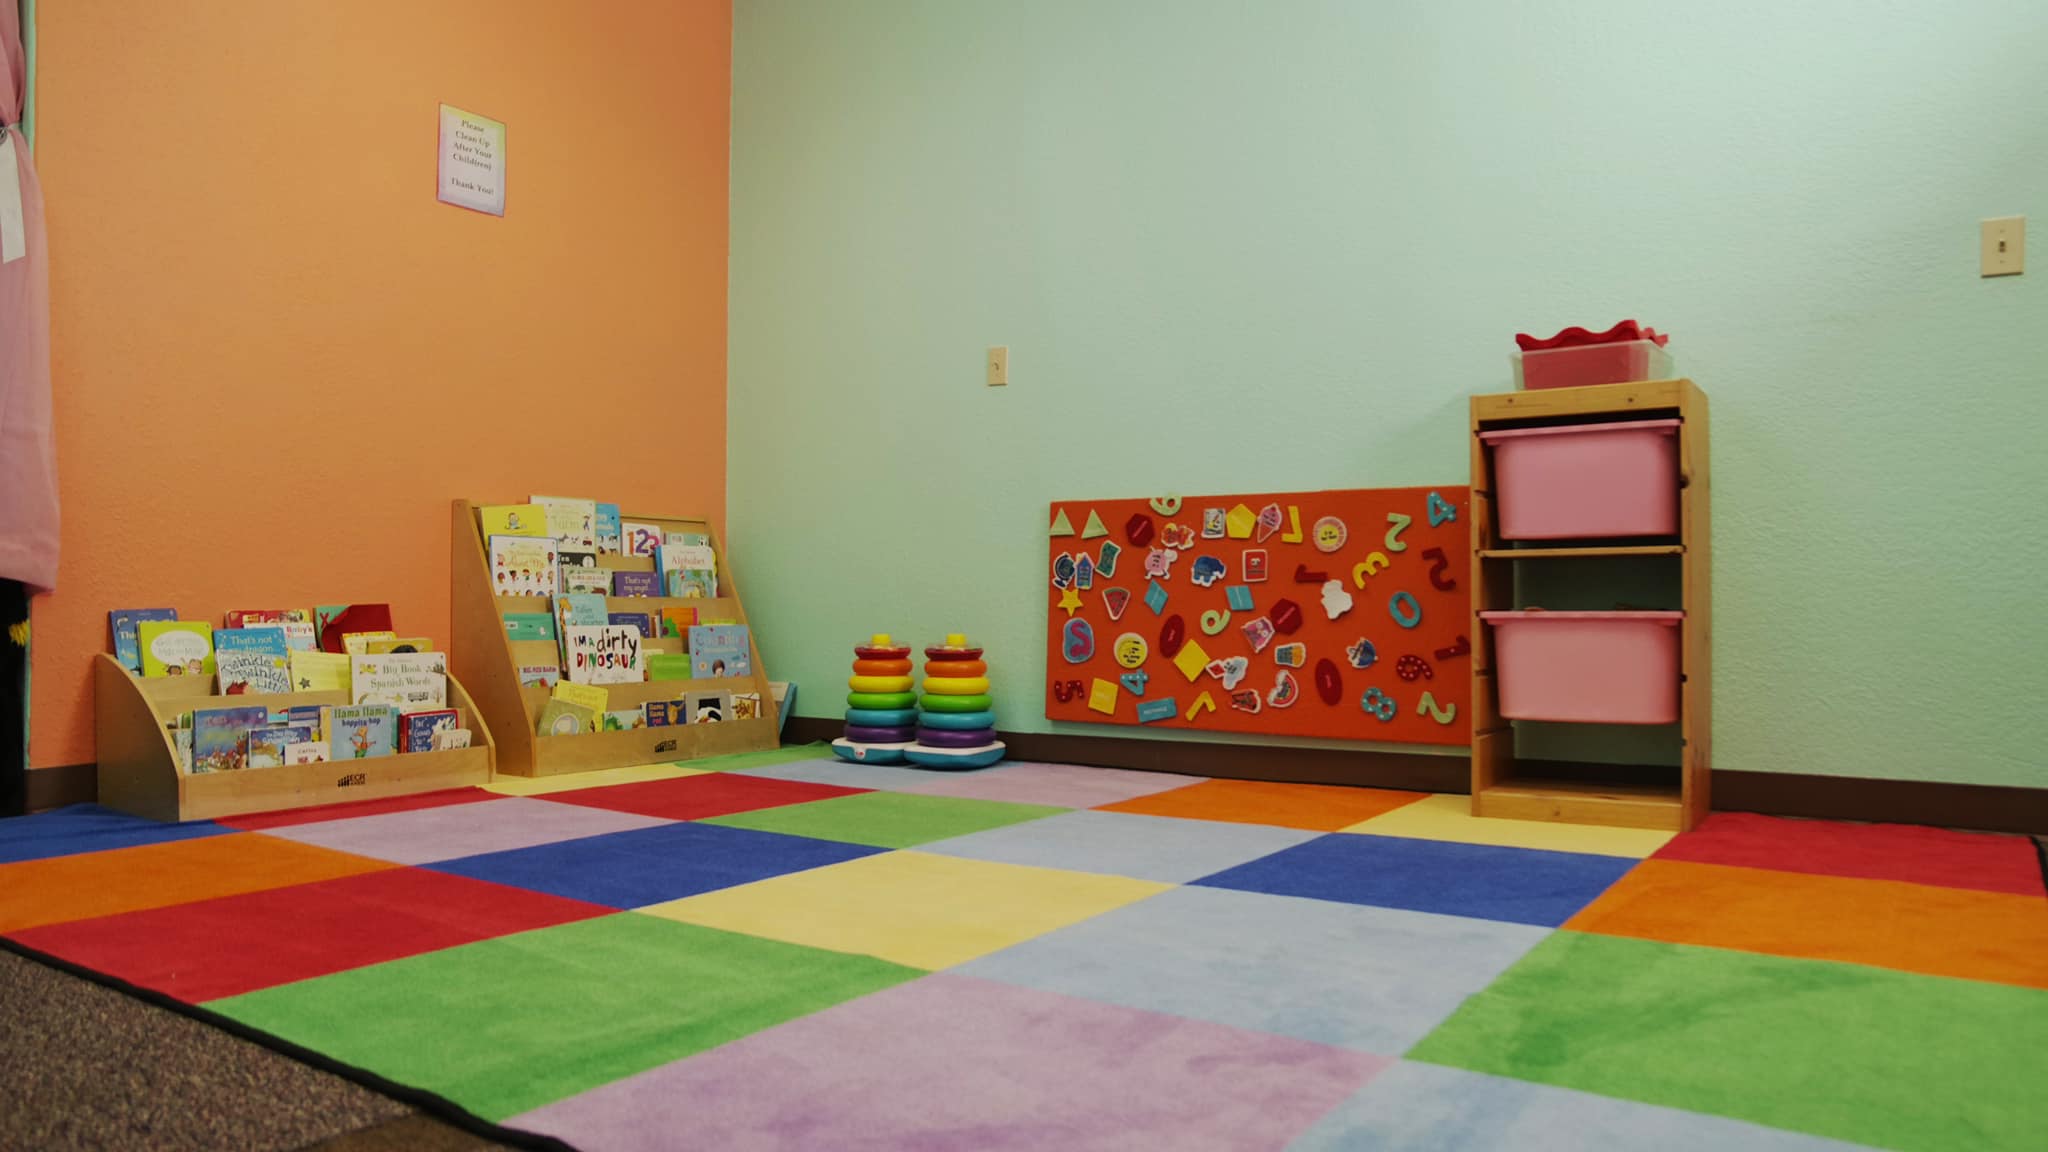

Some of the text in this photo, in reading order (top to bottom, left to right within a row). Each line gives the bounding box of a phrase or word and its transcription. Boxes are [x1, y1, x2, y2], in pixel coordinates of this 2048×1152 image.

[461, 119, 484, 132] Please
[455, 130, 490, 149] Clean Up
[454, 142, 492, 159] After Your
[452, 177, 474, 190] Thank
[230, 635, 273, 645] That's not
[589, 637, 595, 647] A
[596, 628, 637, 658] dirty
[383, 663, 422, 675] Big Book
[577, 652, 636, 672] DINOSAUR
[370, 677, 431, 691] Spanish Words
